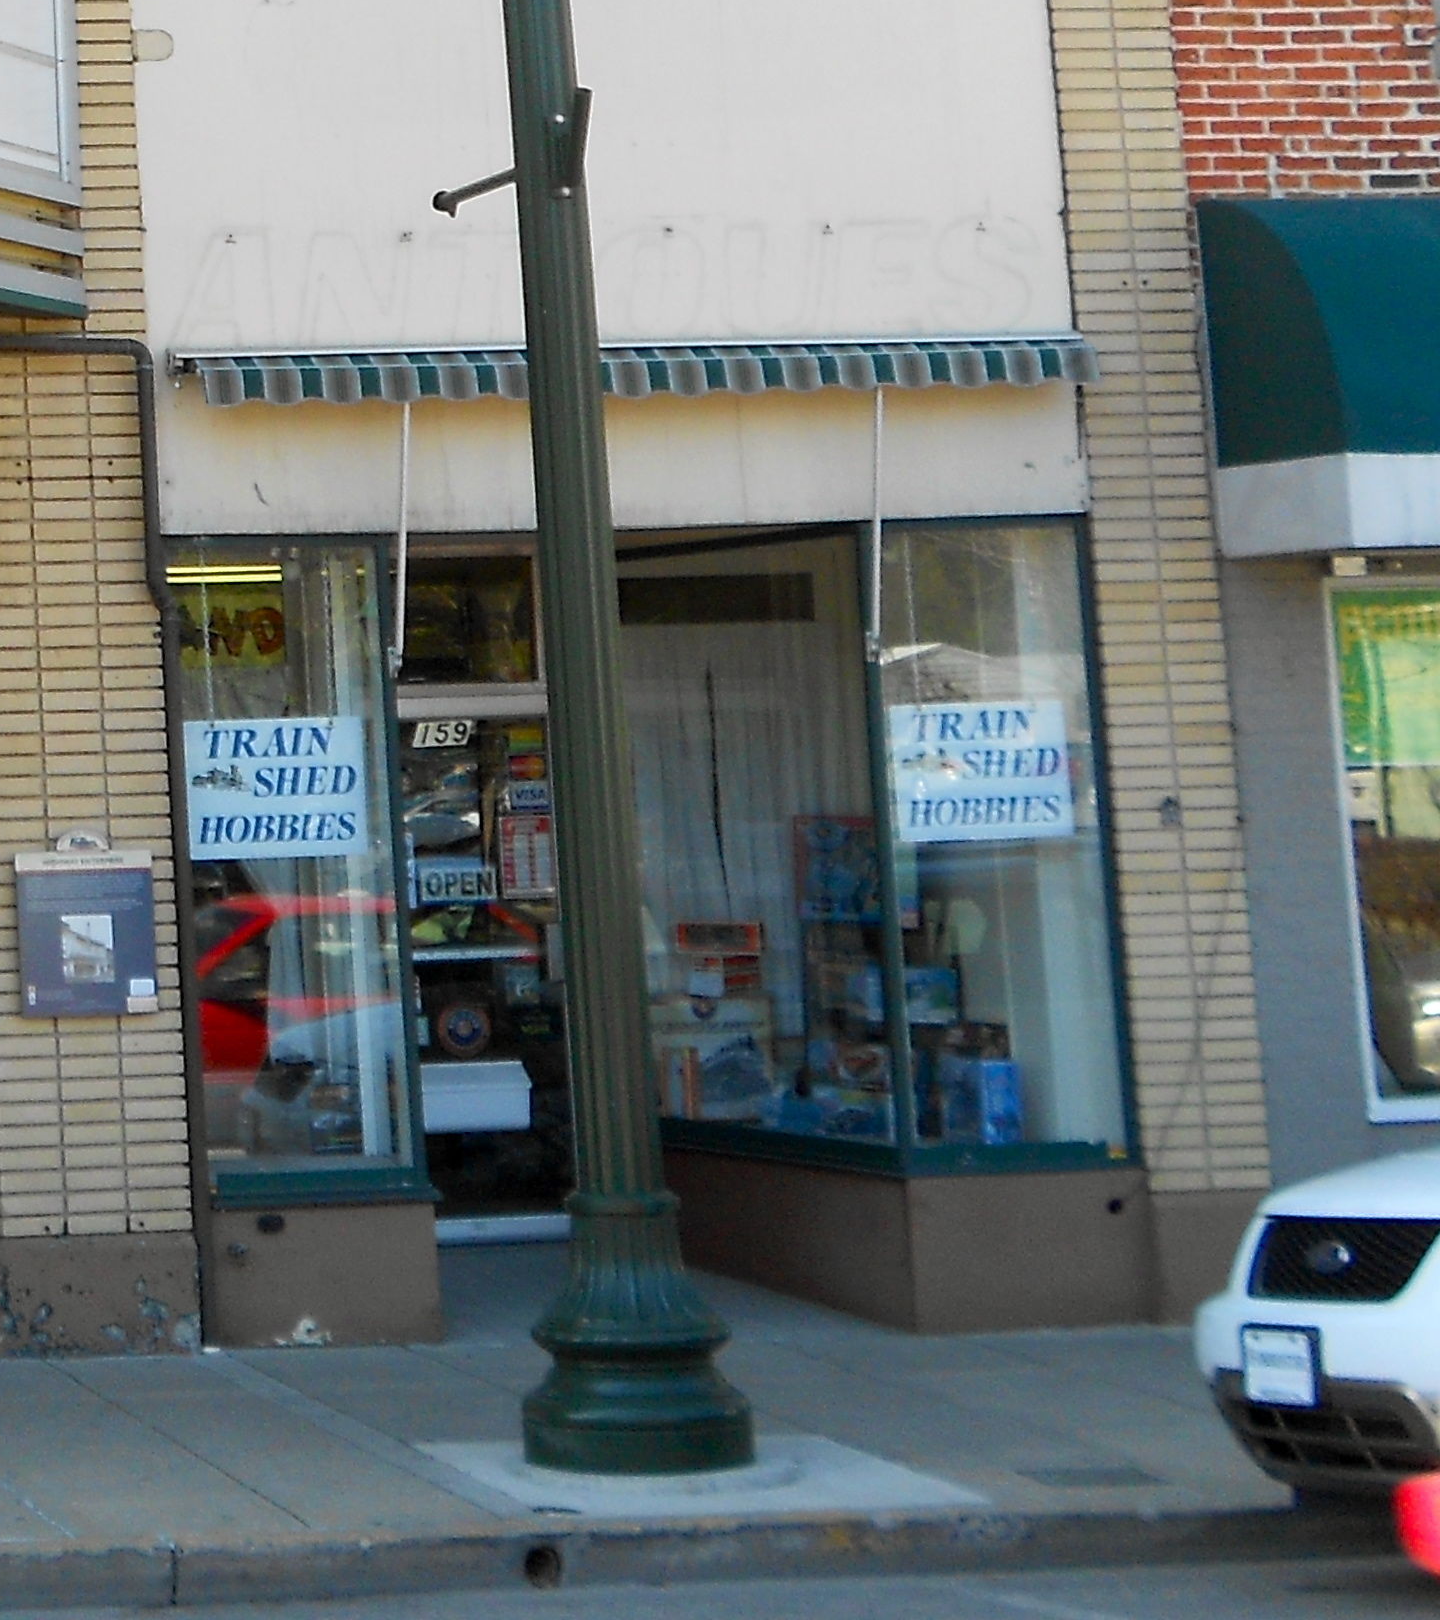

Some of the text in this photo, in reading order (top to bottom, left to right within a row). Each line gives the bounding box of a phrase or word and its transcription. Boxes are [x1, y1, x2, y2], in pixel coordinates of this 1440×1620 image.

[204, 726, 333, 759] TRAIN
[420, 722, 469, 744] 159
[910, 709, 1037, 744] TRAIN
[959, 746, 1060, 779] SHED
[253, 763, 357, 798] SHED
[515, 790, 546, 805] VISA
[906, 795, 1061, 828] HOBBIES
[199, 811, 357, 844] HOBBIES
[425, 873, 495, 896] OPEN
